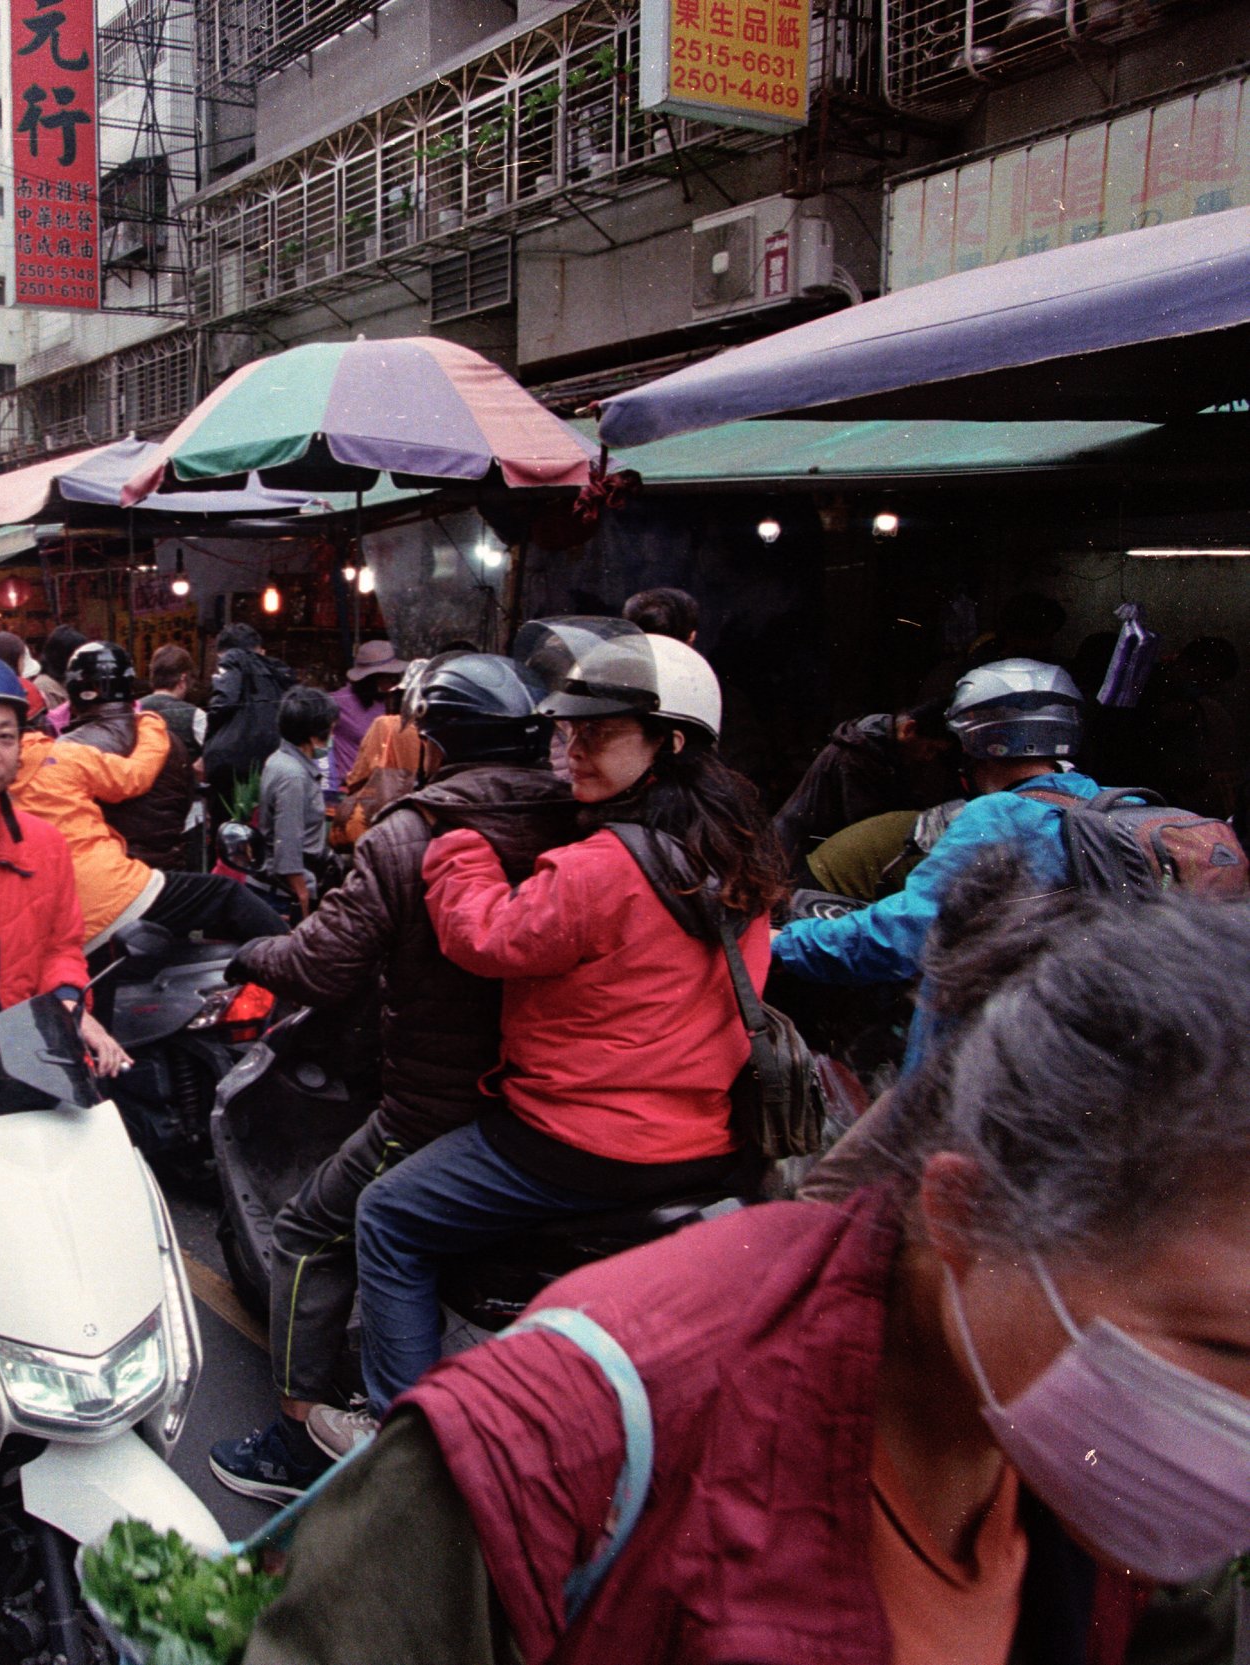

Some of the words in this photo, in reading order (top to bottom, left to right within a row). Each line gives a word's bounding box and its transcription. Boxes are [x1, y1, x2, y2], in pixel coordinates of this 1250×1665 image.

[674, 37, 795, 80] 2515-6631
[673, 65, 799, 108] 2501-4489
[19, 282, 95, 299] 2501-6110
